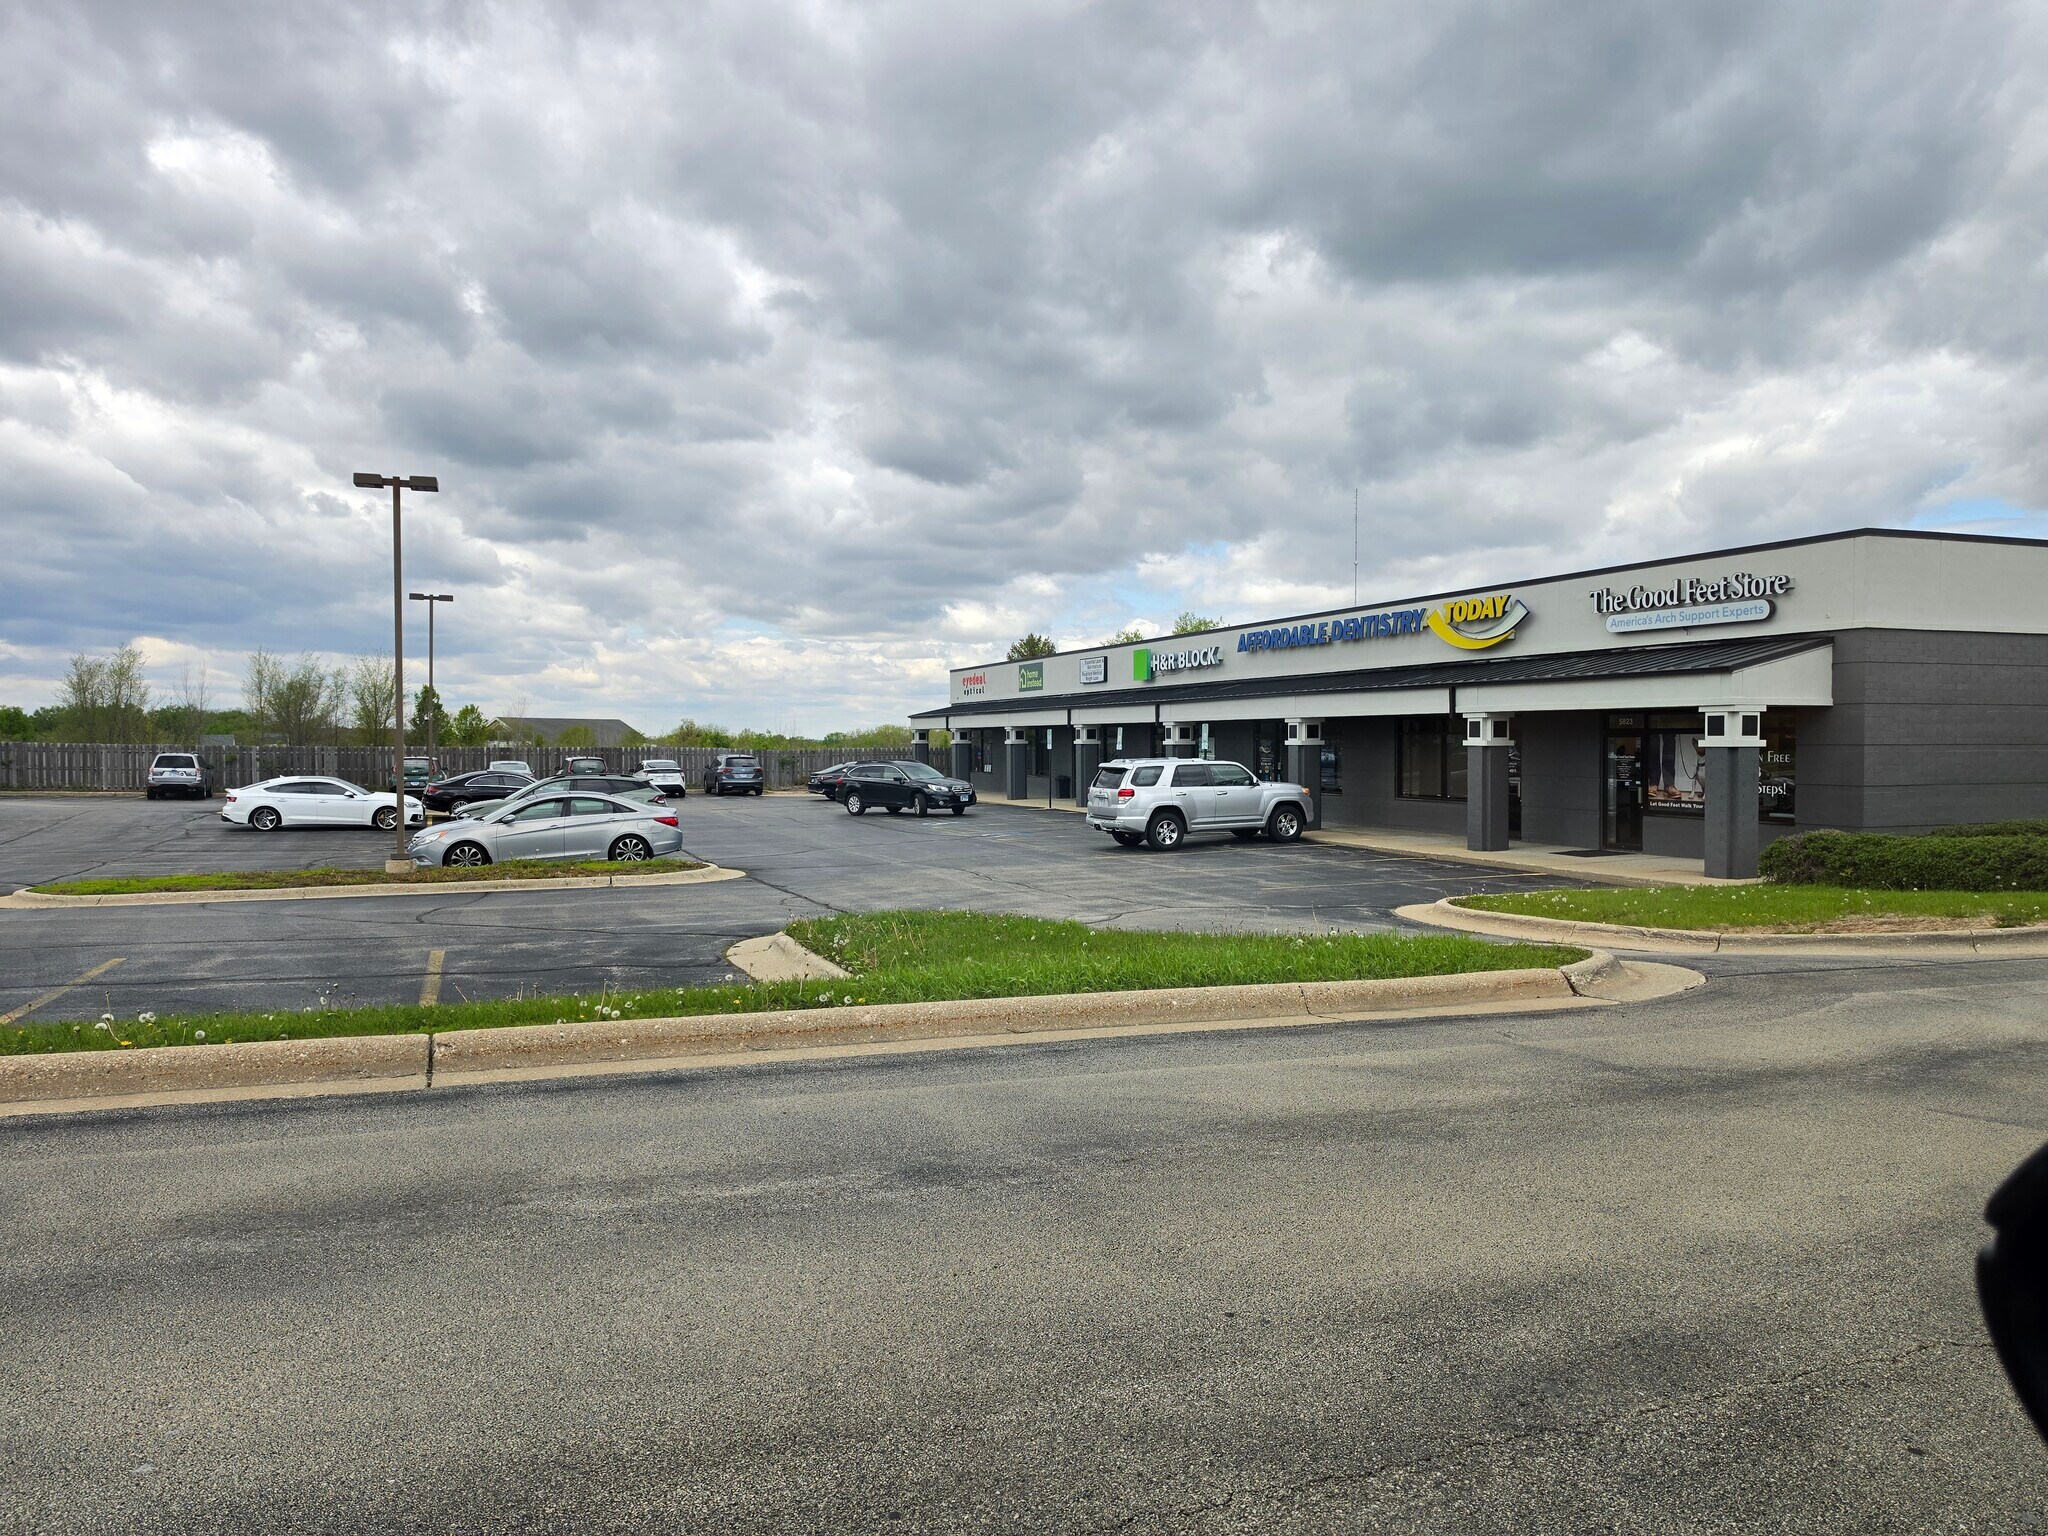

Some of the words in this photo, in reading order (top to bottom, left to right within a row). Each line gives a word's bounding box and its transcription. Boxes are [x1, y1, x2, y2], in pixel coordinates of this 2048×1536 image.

[1590, 588, 1624, 614] The
[1627, 579, 1679, 610] Good
[1684, 577, 1728, 604] Feet
[1731, 572, 1787, 599] Store
[1443, 594, 1512, 624] TODAY
[1610, 616, 1653, 628] America's
[1655, 613, 1677, 624] Arch
[1679, 608, 1720, 624] Support
[1722, 604, 1764, 620] Experts
[1237, 622, 1329, 653] AFFORDABLE
[1331, 608, 1428, 641] DENTISTRY
[1152, 653, 1176, 672] H&R
[1179, 648, 1217, 667] BLOCK
[962, 672, 986, 688] eyedeal
[1026, 670, 1038, 678] home
[1026, 678, 1042, 688] instead
[963, 686, 985, 696] optical
